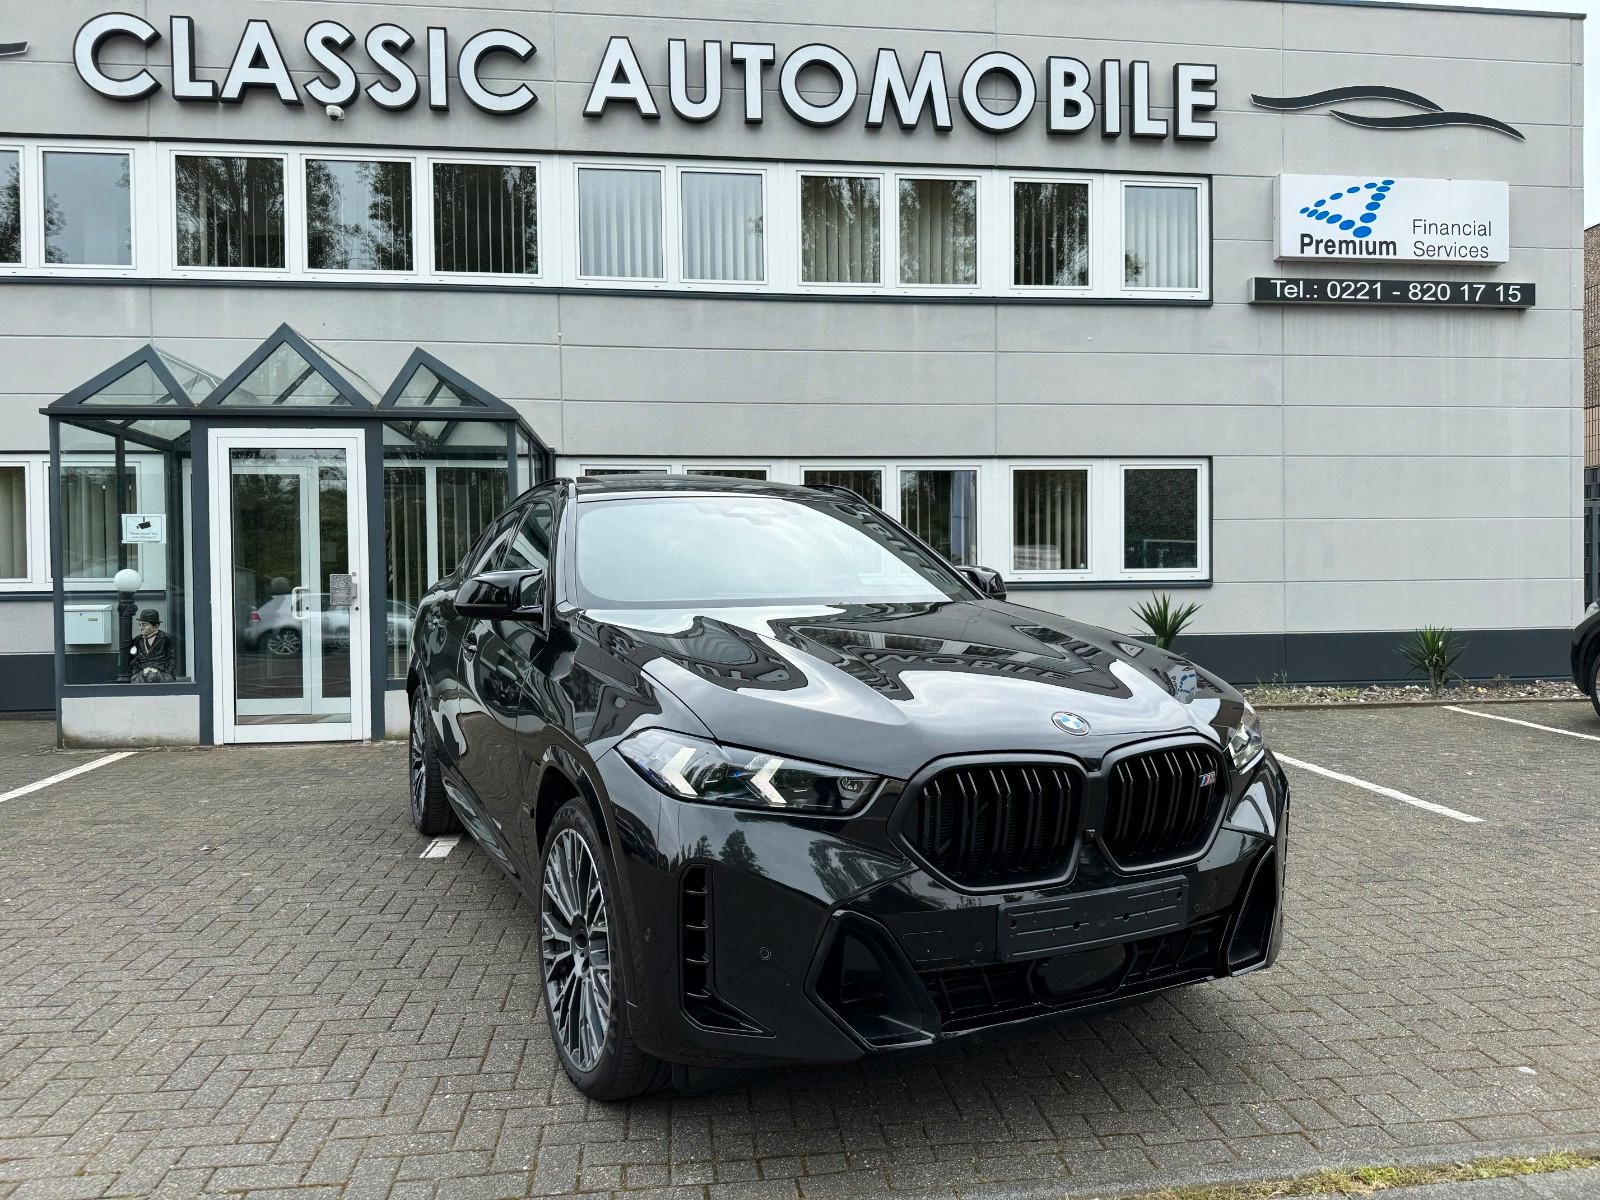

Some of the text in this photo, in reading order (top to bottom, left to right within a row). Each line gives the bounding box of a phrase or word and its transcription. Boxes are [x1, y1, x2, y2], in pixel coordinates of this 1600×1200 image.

[73, 12, 1217, 141] CLASSIC AUTOMOBILE
[1412, 218, 1492, 237] Financial
[1300, 233, 1397, 256] Premium
[1413, 240, 1489, 259] Services
[1270, 280, 1318, 298] Tel.:
[1326, 281, 1381, 300] 0221
[1408, 283, 1451, 301] 820
[1460, 284, 1486, 302] 17
[1495, 285, 1521, 302] 15
